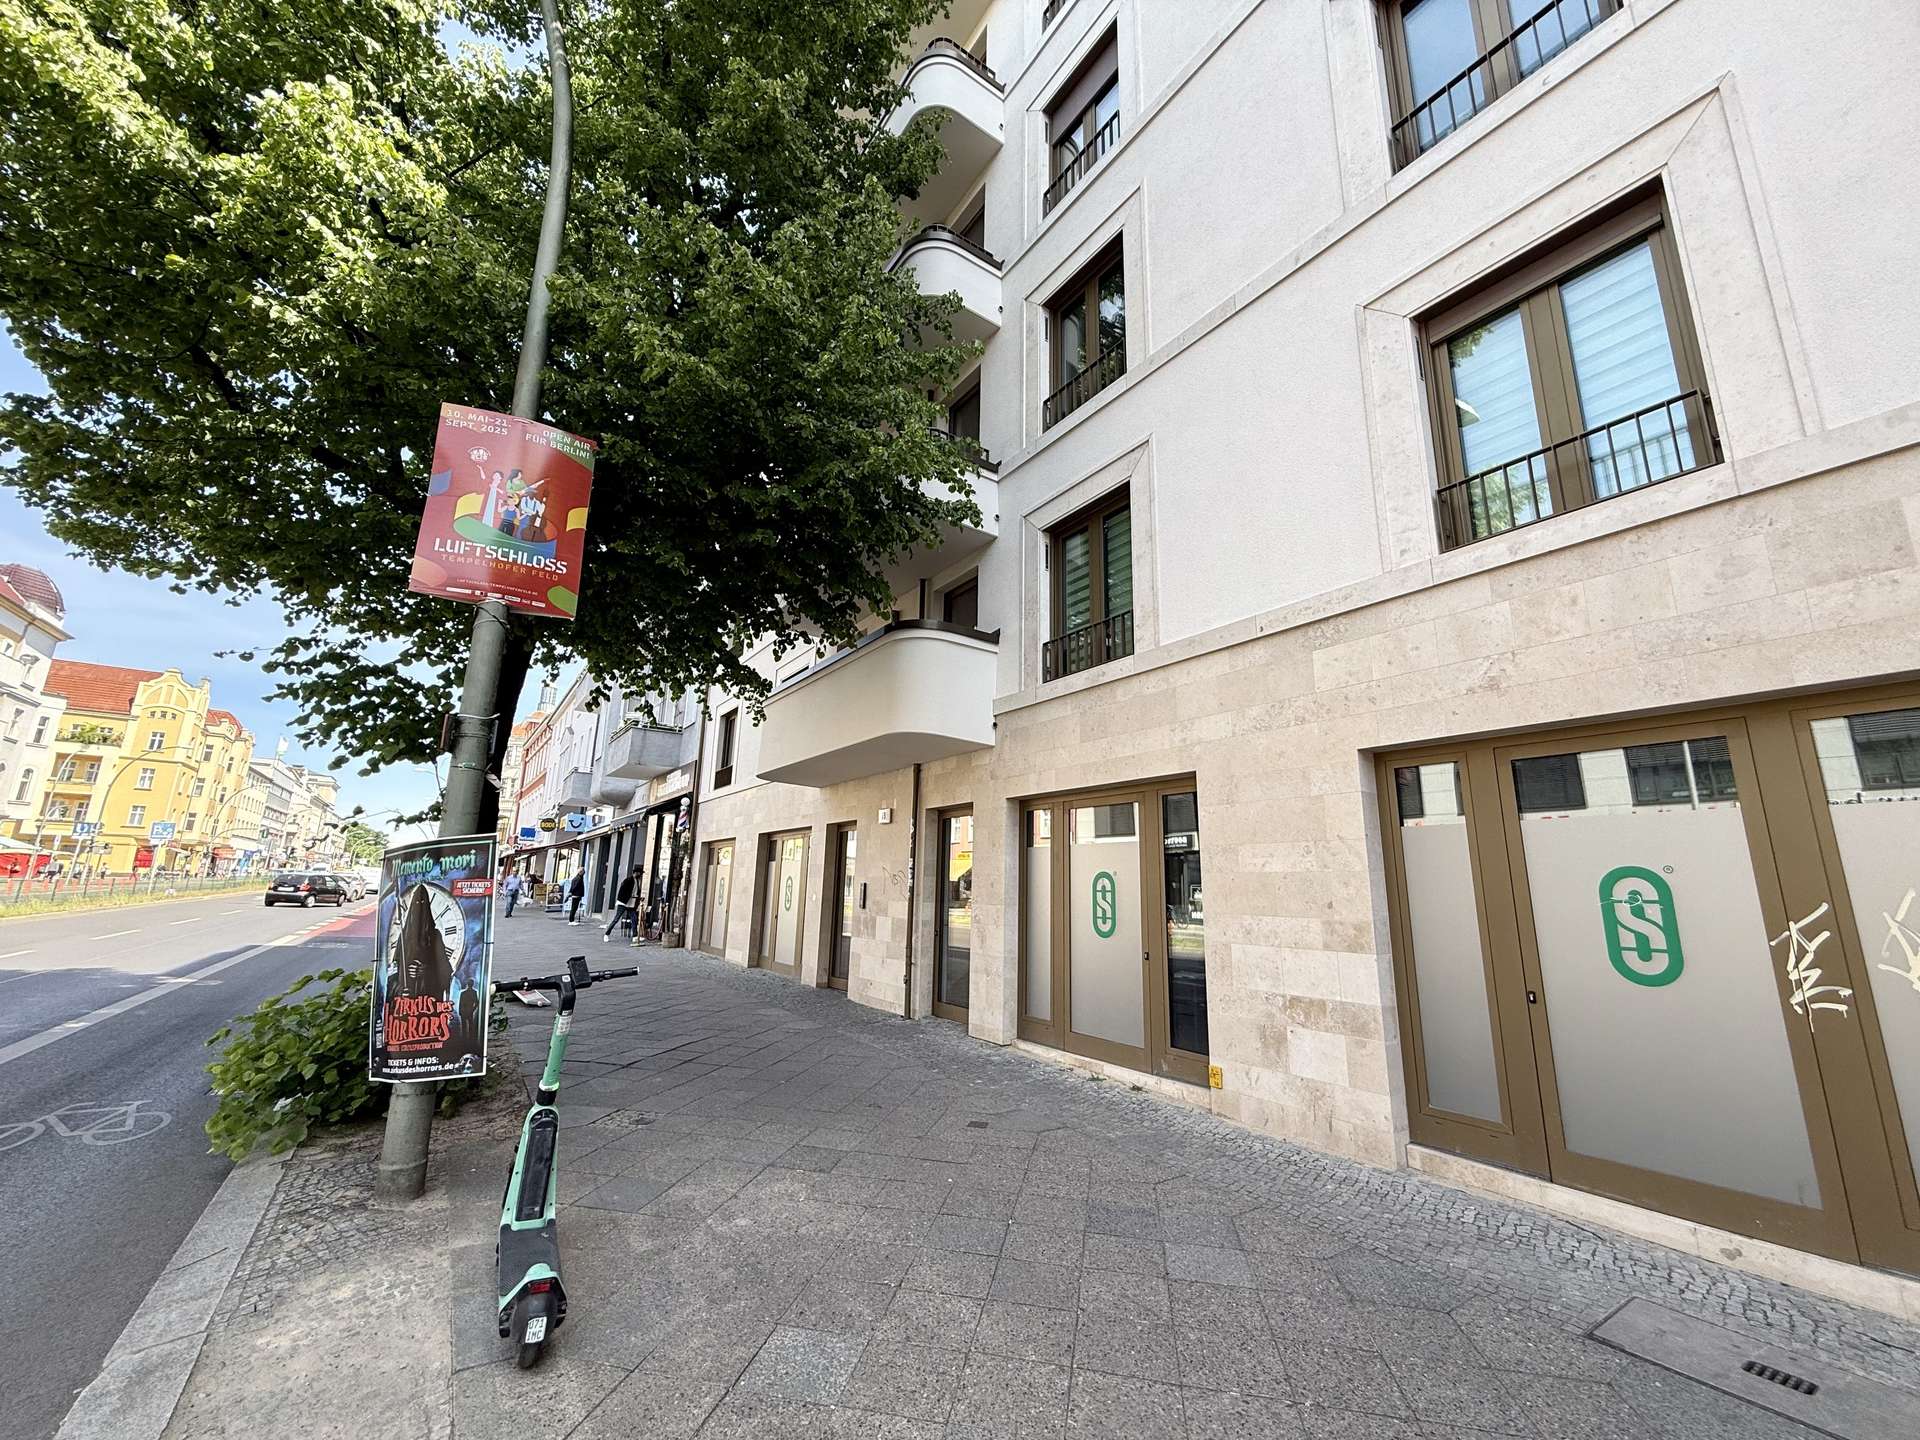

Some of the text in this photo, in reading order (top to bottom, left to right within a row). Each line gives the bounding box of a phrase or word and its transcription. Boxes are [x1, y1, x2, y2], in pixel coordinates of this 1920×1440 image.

[447, 410, 464, 418] 10.
[446, 419, 508, 435] SEPT. 2025
[525, 433, 590, 459] FÜR BERLIN!
[543, 430, 591, 450] OPEN AIR
[434, 537, 568, 575] LUFTSCHLOSS
[441, 554, 559, 581] TEMPELHOFER FELD
[391, 849, 476, 877] Memento mori
[393, 995, 435, 1017] ZIRKUS
[384, 1002, 450, 1044] HORRORS
[387, 1058, 407, 1067] TICKETS
[414, 1057, 439, 1065] INFOS:
